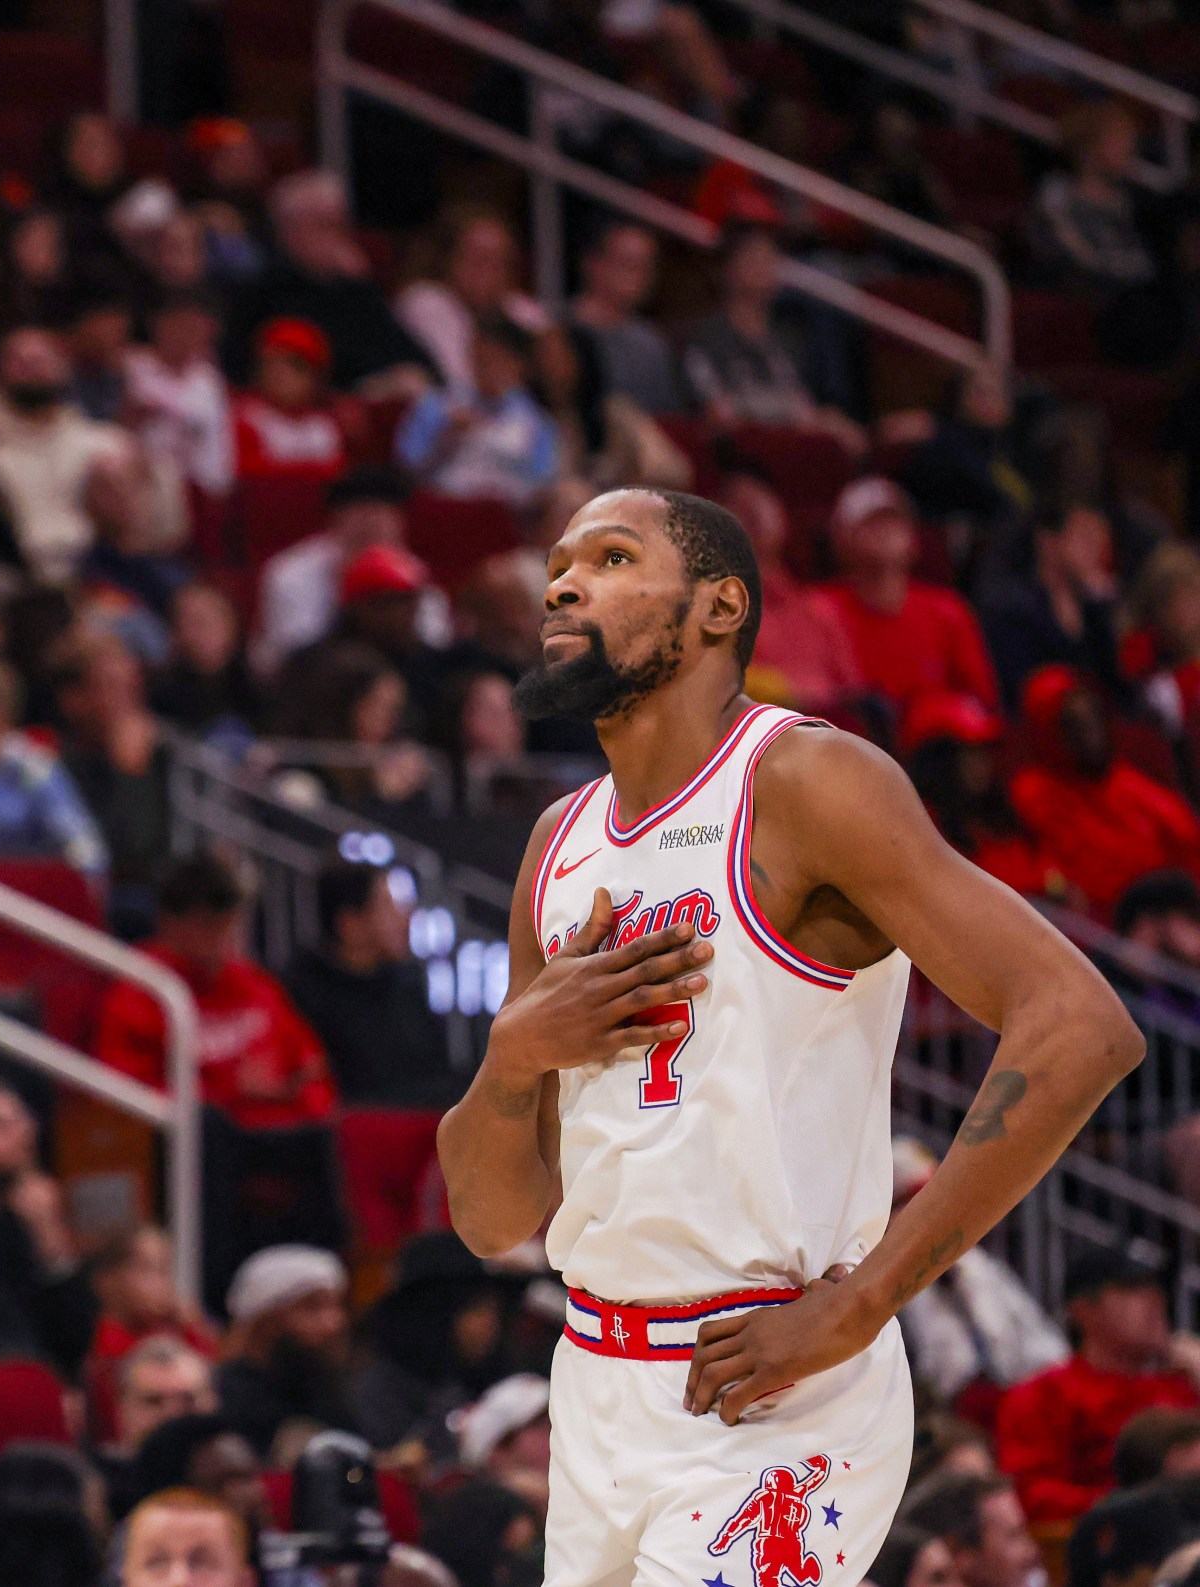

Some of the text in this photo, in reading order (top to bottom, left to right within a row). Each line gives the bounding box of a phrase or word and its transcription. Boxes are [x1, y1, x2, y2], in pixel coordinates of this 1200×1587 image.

[659, 831, 723, 850] HERMANN
[660, 823, 725, 840] MEMORIAL
[631, 997, 695, 1109] 7
